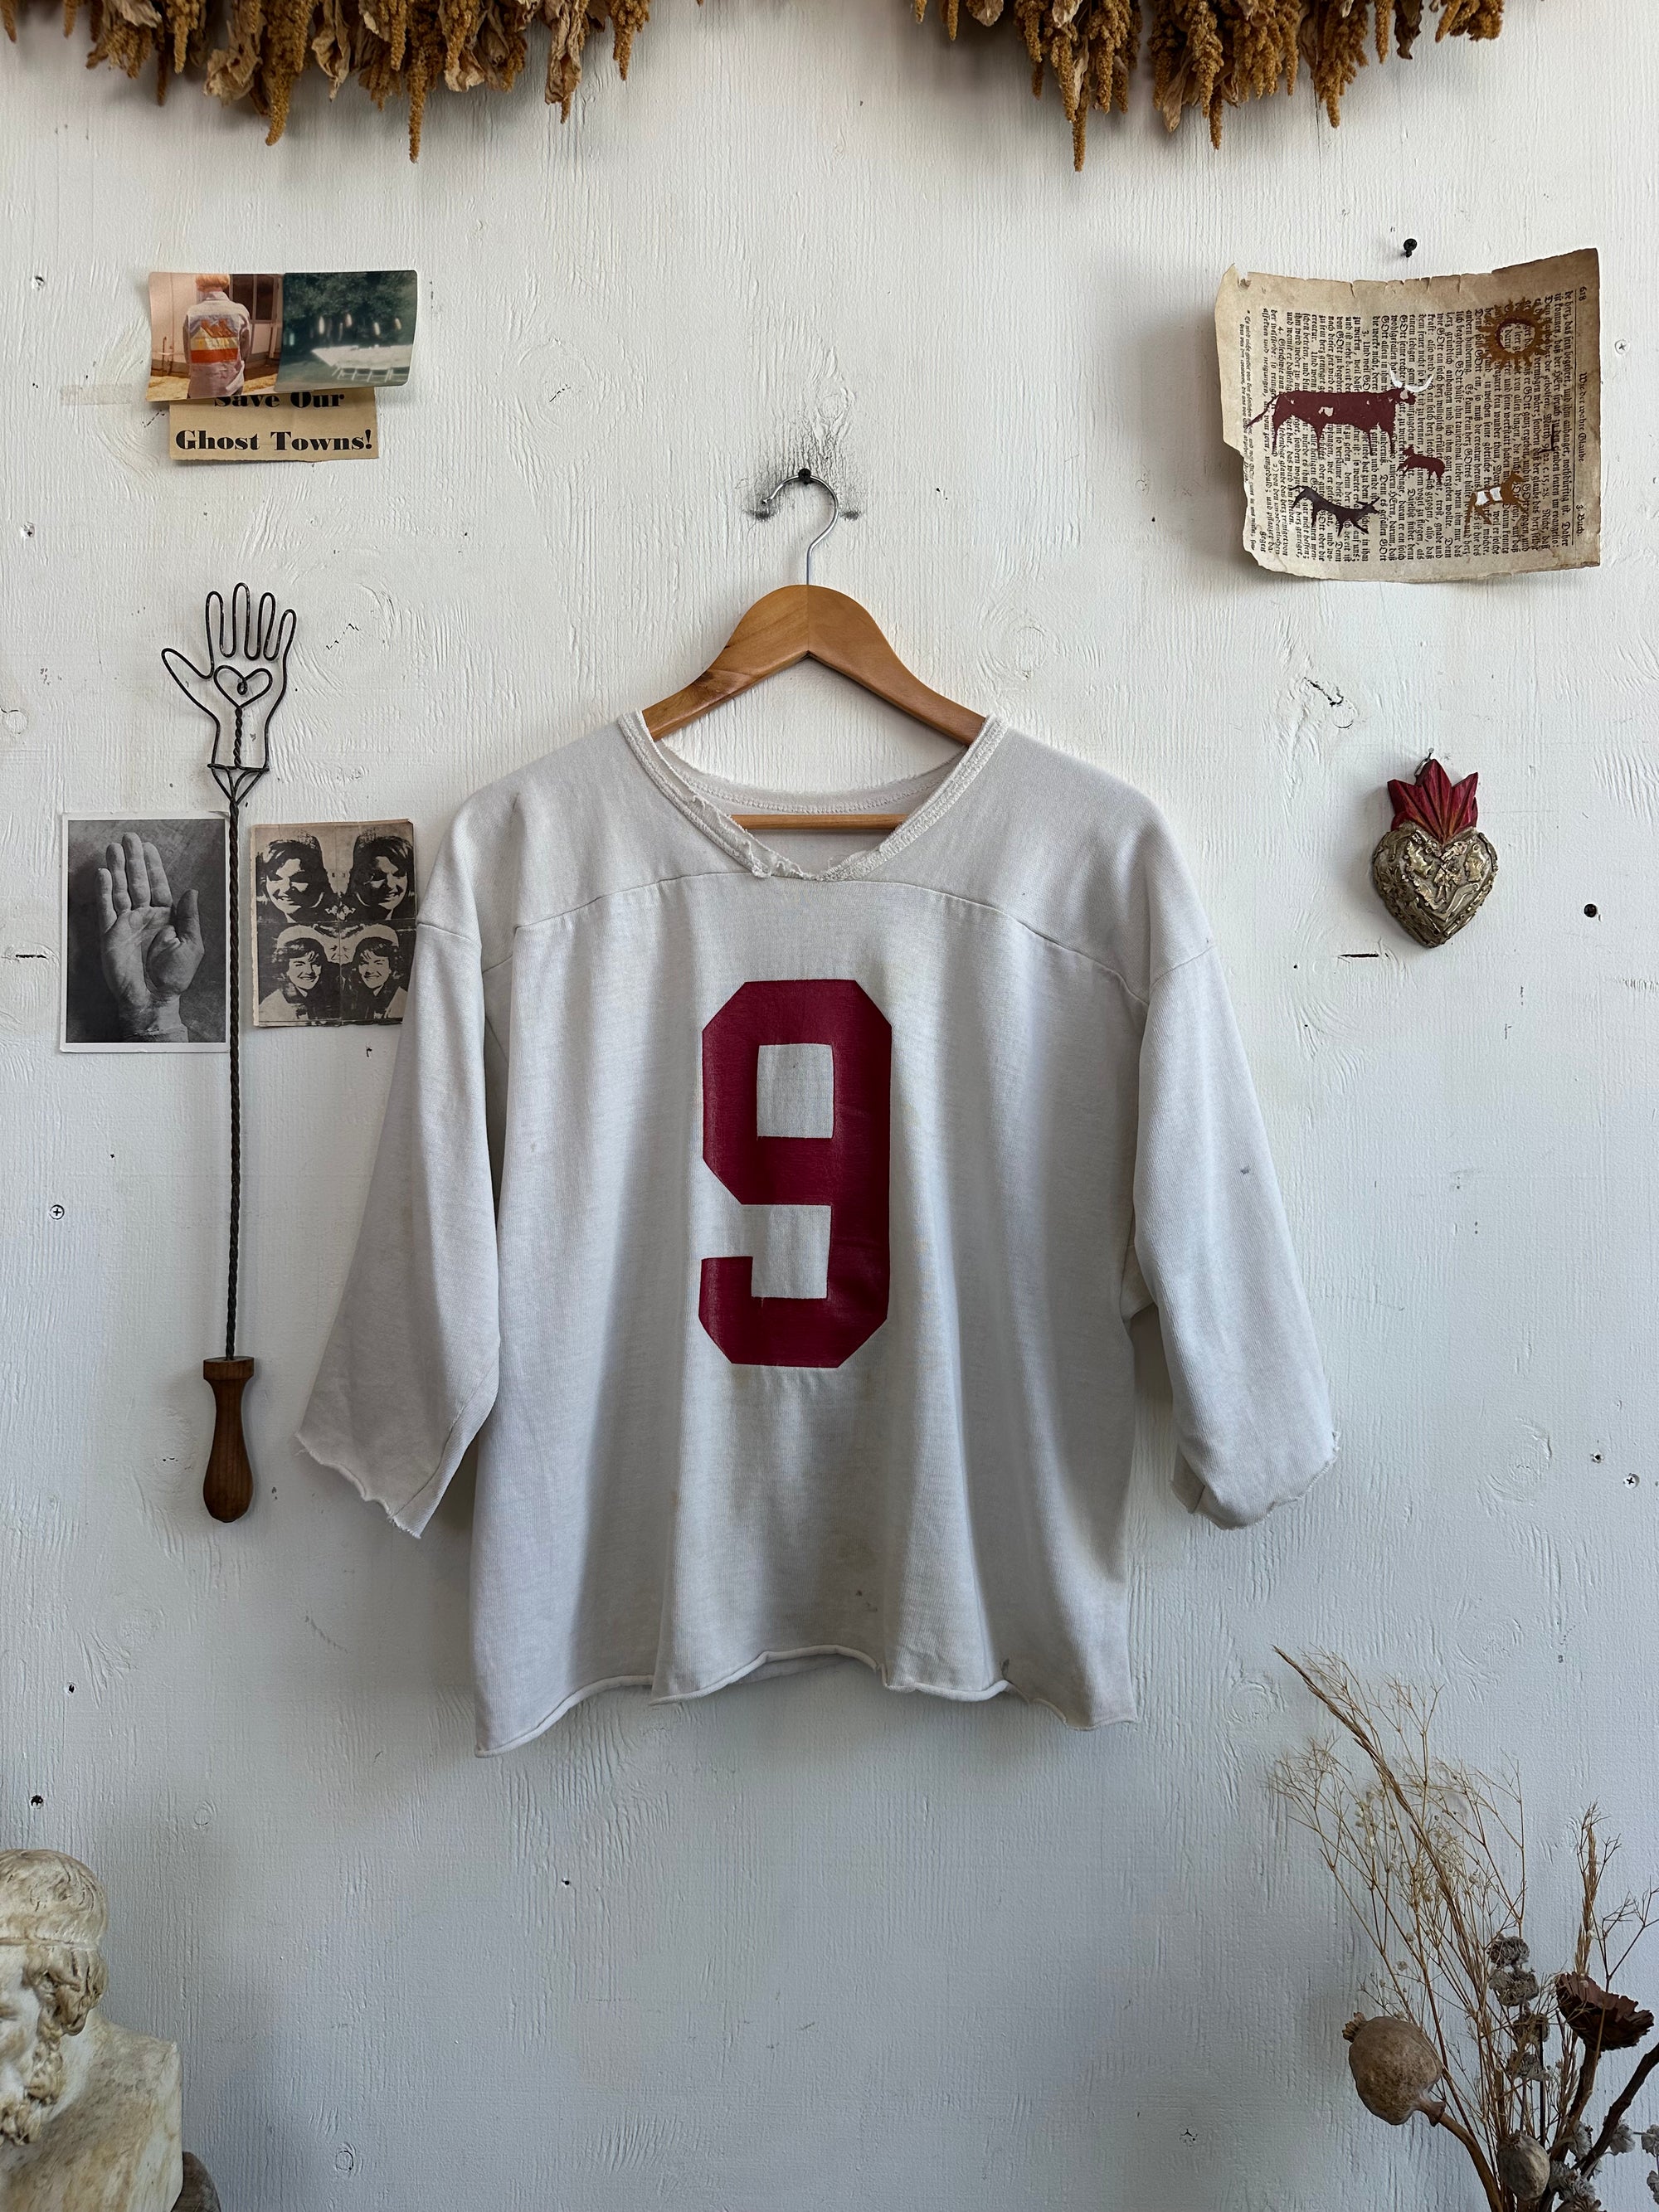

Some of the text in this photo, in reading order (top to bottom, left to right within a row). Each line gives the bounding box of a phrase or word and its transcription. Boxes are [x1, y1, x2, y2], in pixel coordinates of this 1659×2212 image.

[290, 391, 344, 408] Our
[1562, 405, 1570, 418] ihm
[176, 429, 372, 450] Ghost Towns!
[698, 979, 893, 1369] 9
